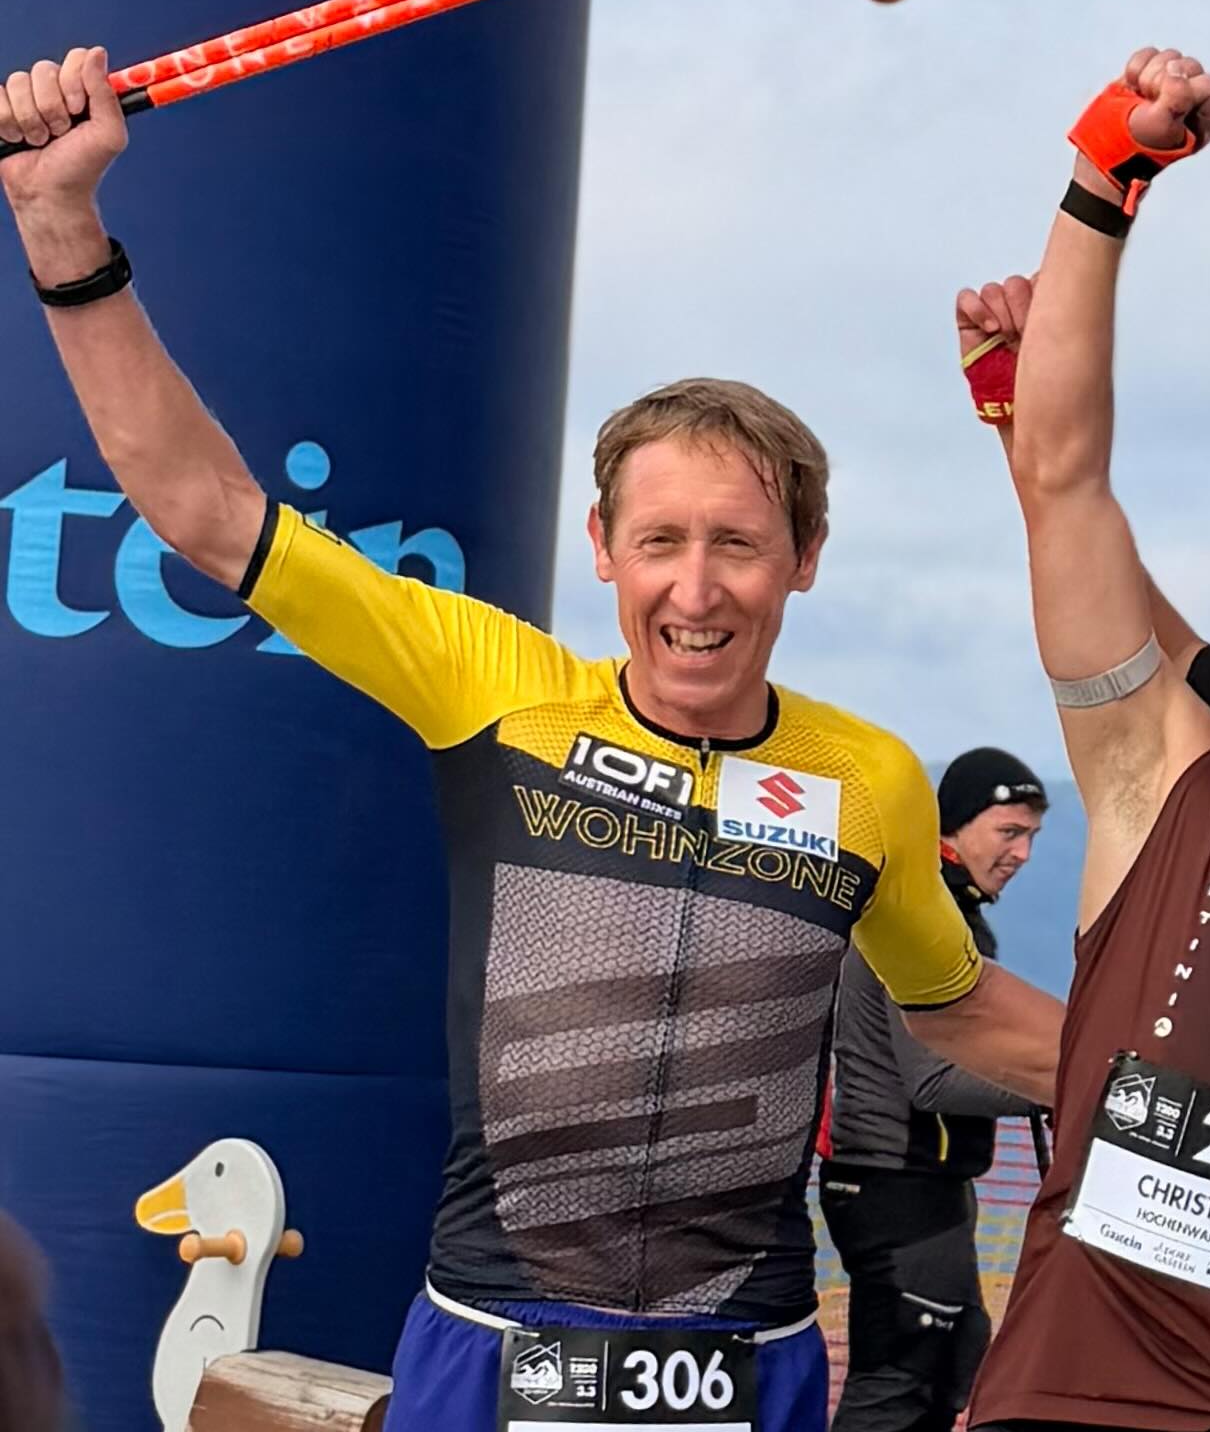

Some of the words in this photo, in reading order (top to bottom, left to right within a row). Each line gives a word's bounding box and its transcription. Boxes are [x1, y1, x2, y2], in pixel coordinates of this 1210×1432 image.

[564, 769, 640, 805] AUSTRIAN
[641, 797, 682, 821] BIKES
[513, 784, 861, 910] WOHNZONE
[722, 818, 837, 857] SUZUKI
[1100, 1223, 1143, 1251] Gastein
[620, 1349, 735, 1411] 306
